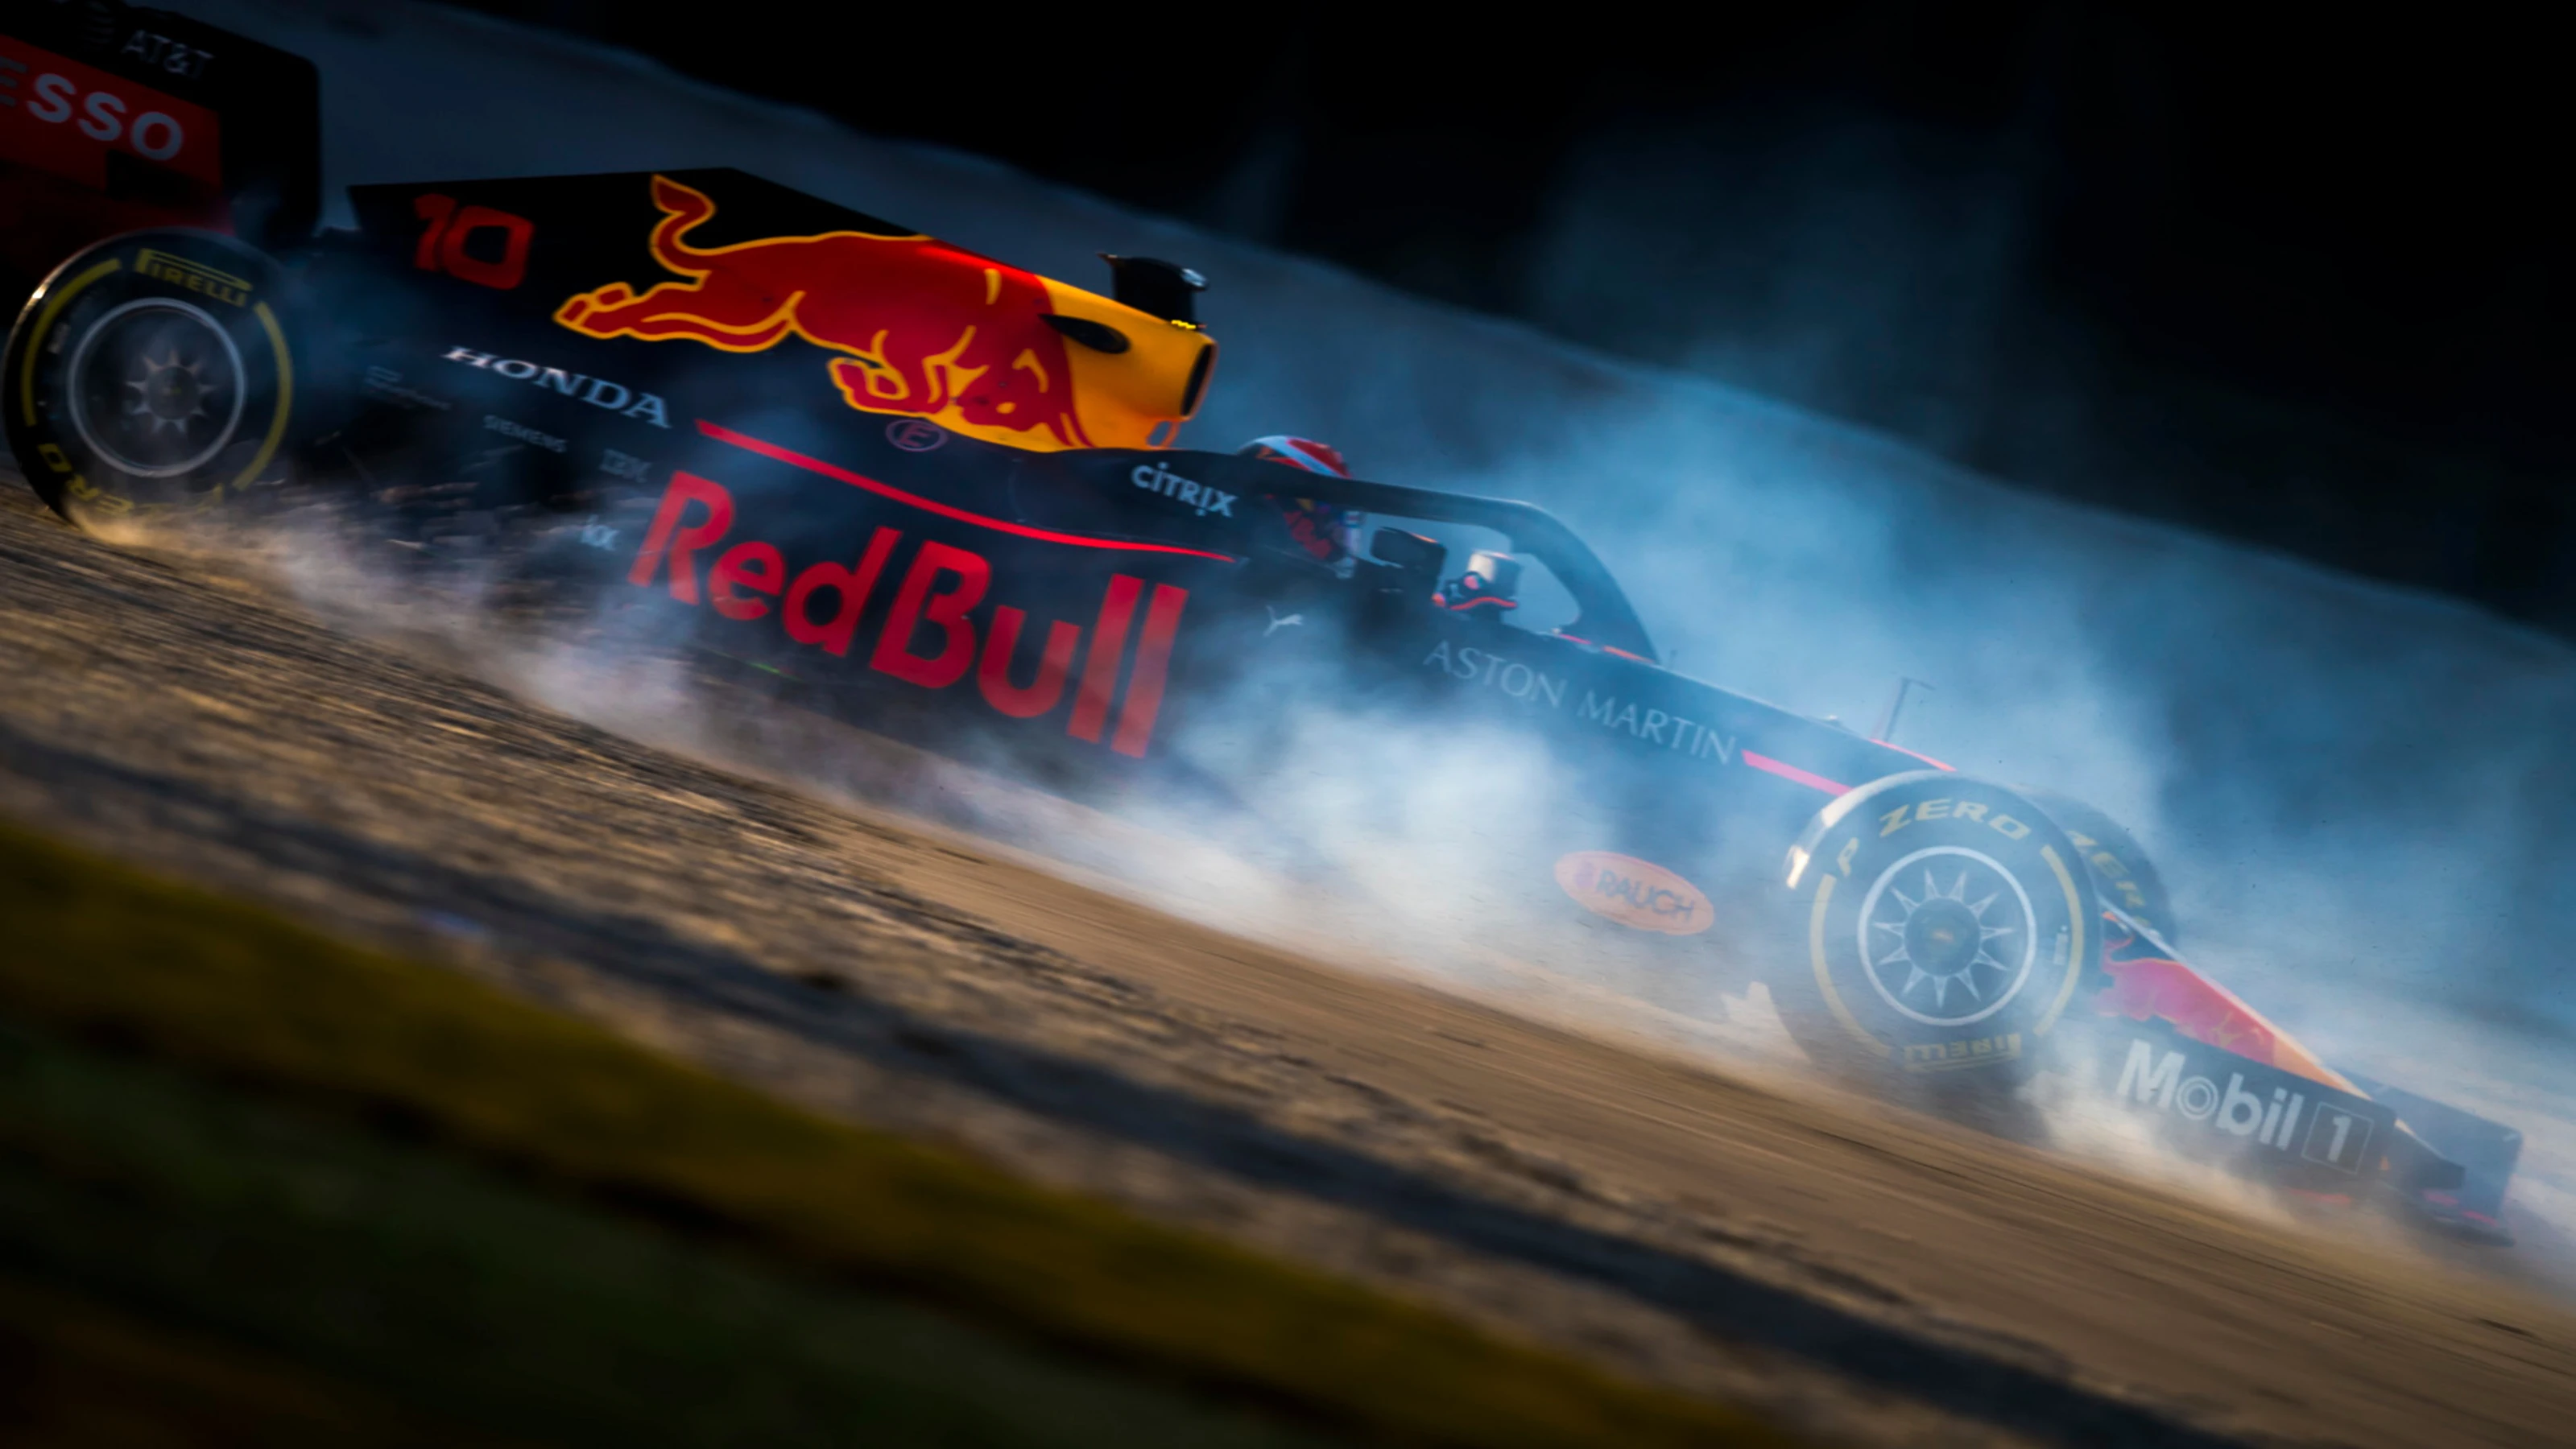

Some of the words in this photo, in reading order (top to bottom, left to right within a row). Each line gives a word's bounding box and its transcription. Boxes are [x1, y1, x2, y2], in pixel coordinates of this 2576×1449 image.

[120, 29, 217, 80] AT&T
[134, 247, 254, 308] PIRELLI
[414, 193, 534, 291] 10
[440, 345, 673, 429] HONDA
[1423, 642, 1568, 709] ASTON
[1577, 690, 1737, 765] MARTIN
[1879, 798, 2032, 841] ZERO
[1595, 869, 1695, 924] RAUCH
[2115, 1038, 2305, 1151] Mobil
[2321, 1114, 2353, 1162] 1
